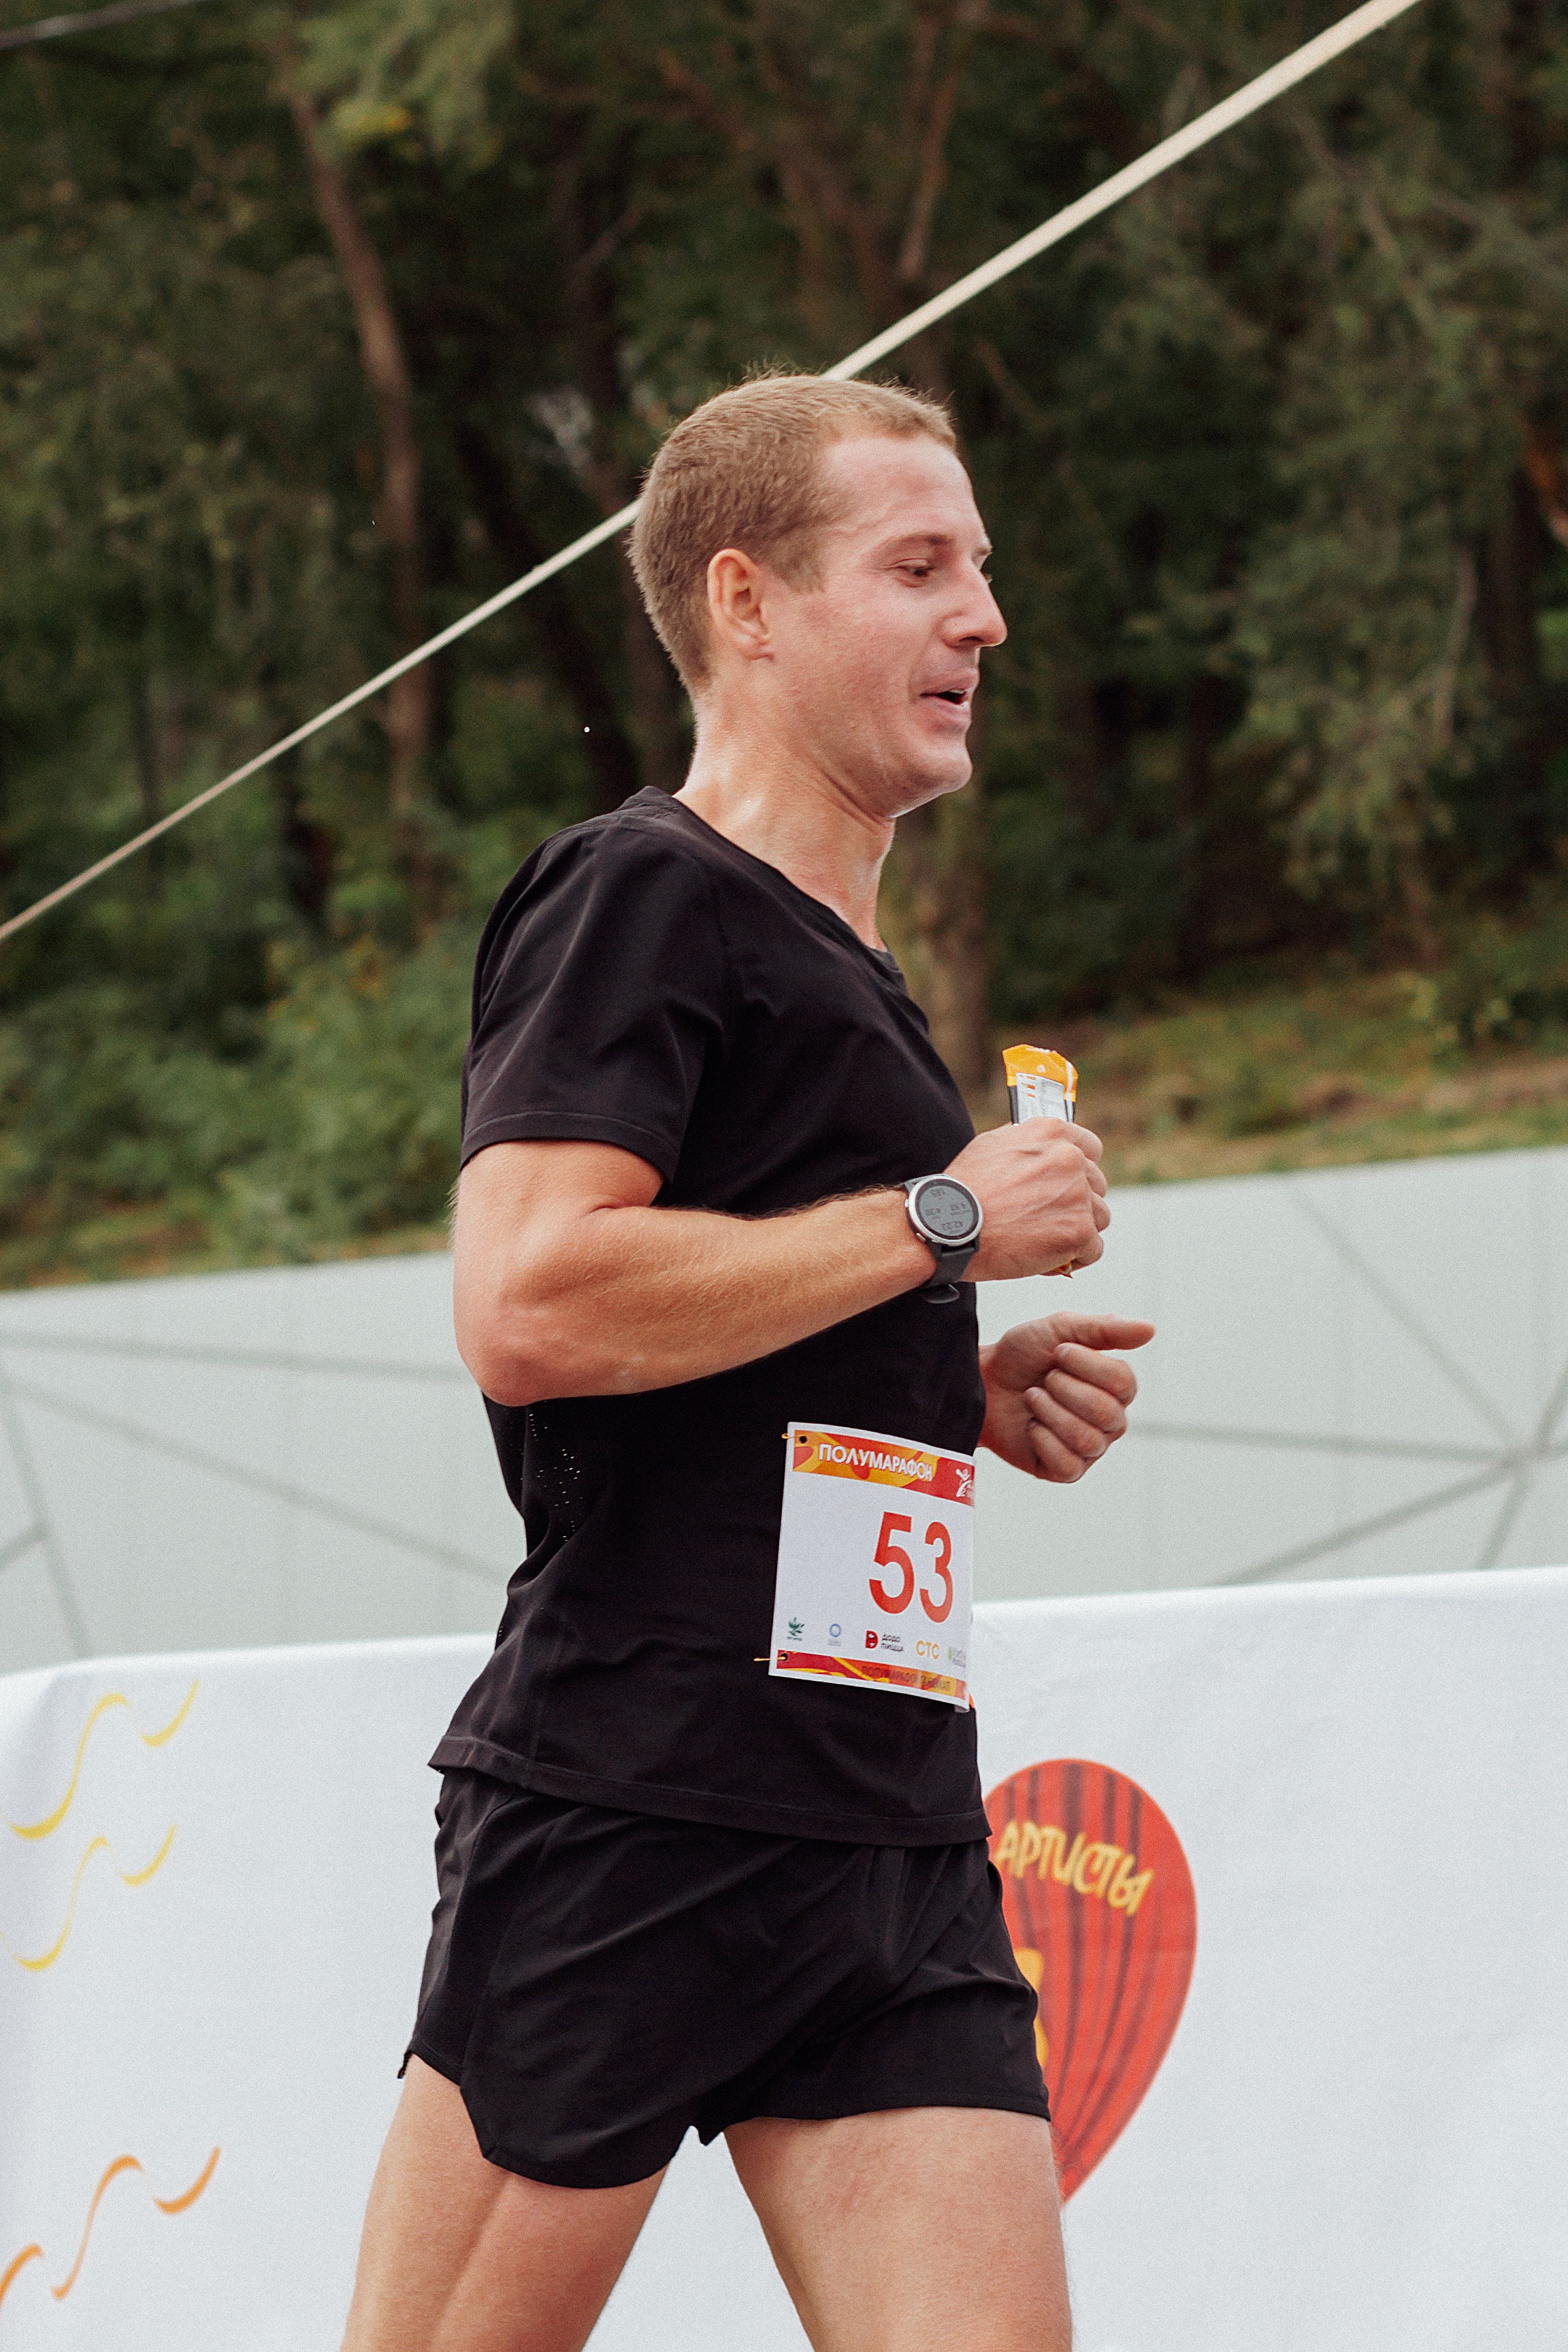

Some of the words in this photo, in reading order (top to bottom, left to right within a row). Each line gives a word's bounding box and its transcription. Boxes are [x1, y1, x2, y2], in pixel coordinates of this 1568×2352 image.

[819, 1443, 933, 1482] ПОЛУМАРАФОН
[868, 1511, 954, 1624] 53
[916, 1640, 940, 1659] СТС
[994, 1819, 1154, 1916] АРТИСТЫ
